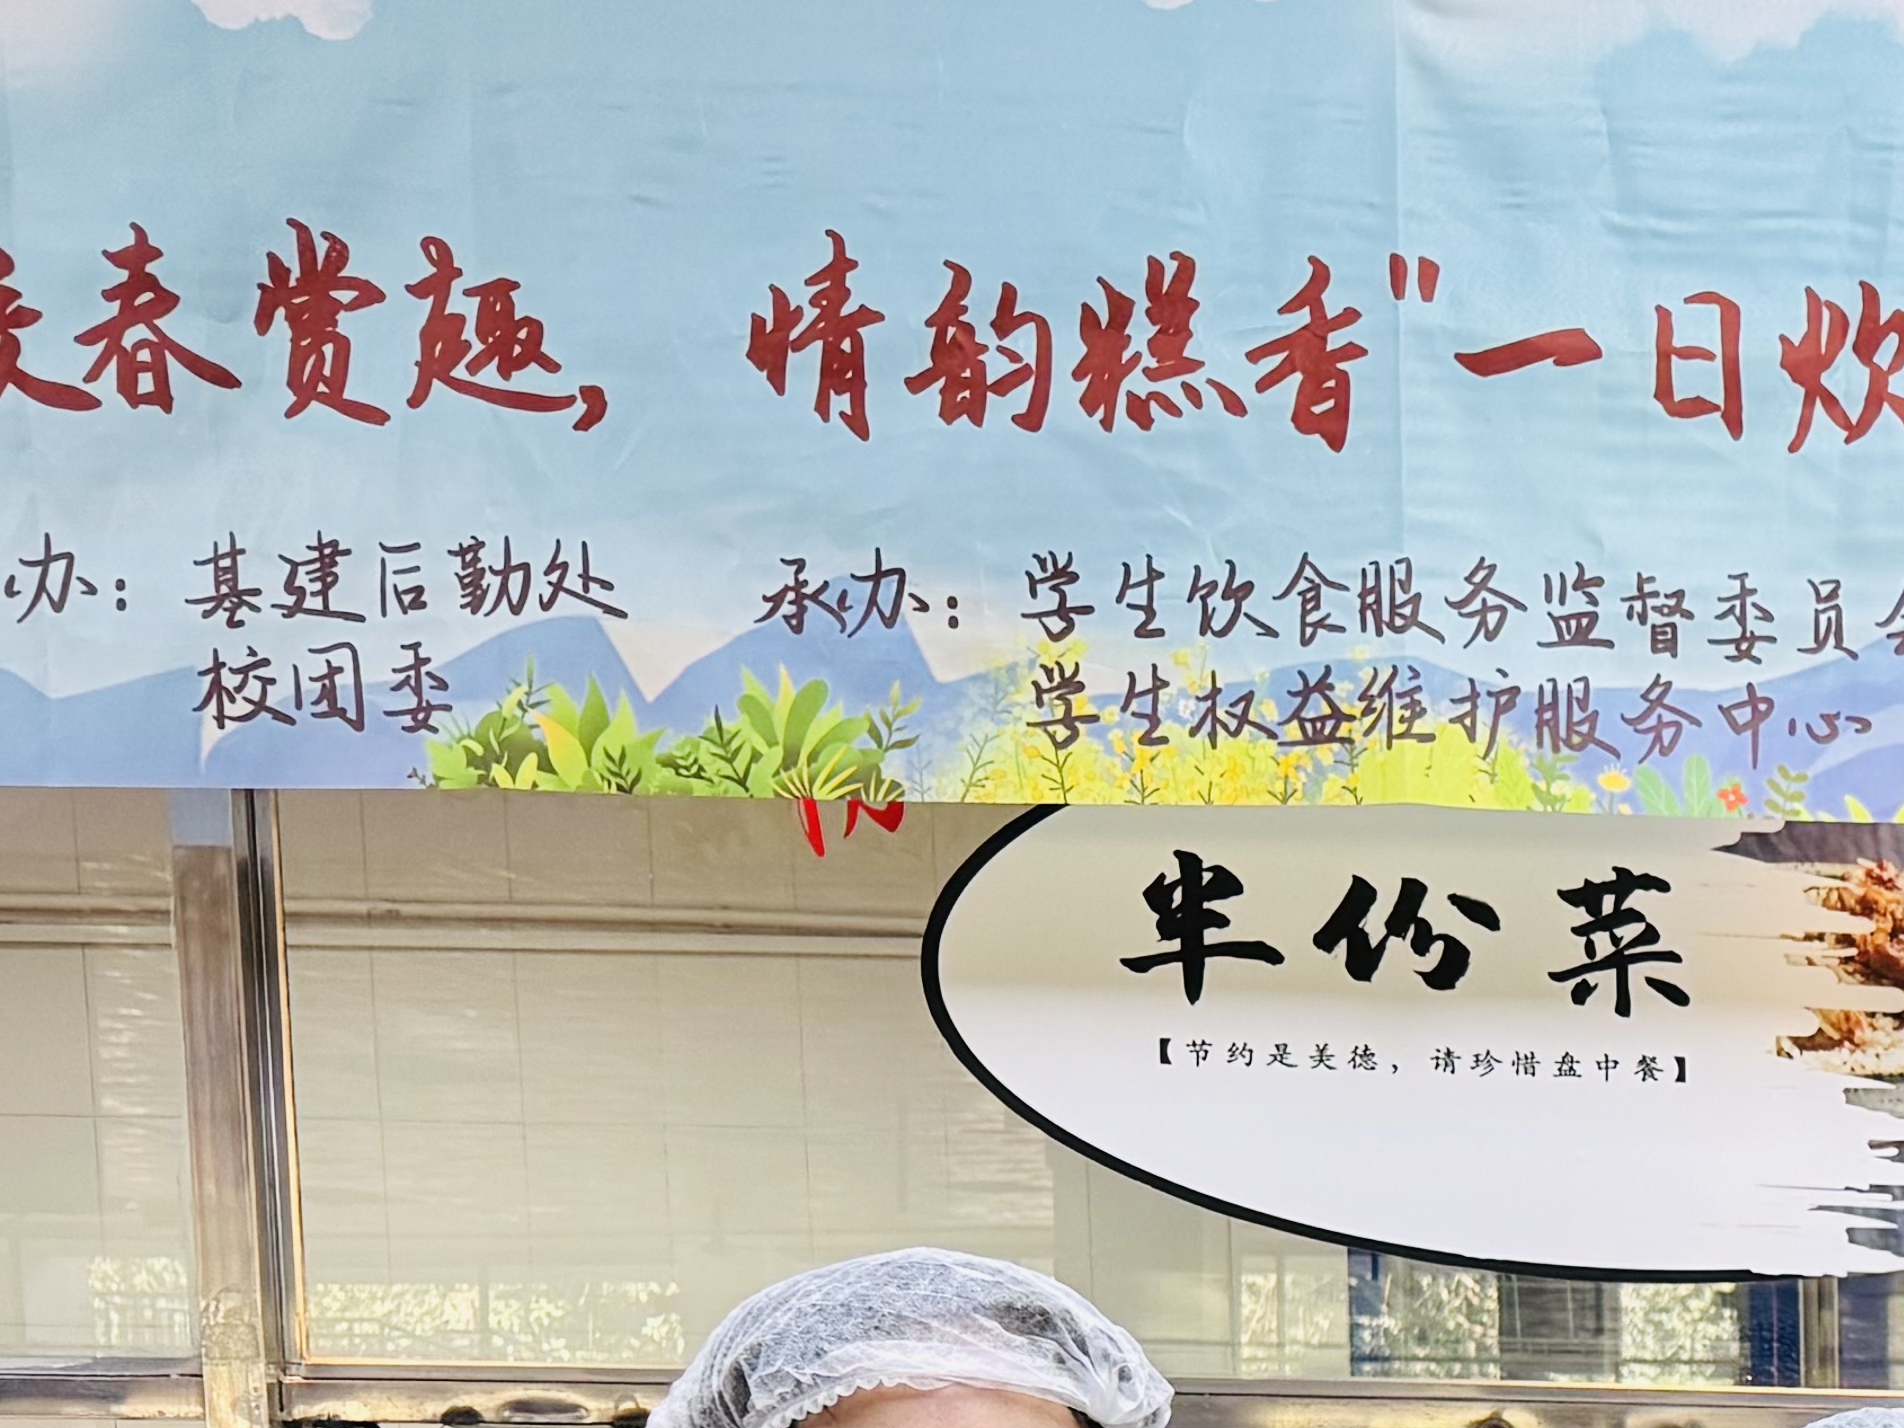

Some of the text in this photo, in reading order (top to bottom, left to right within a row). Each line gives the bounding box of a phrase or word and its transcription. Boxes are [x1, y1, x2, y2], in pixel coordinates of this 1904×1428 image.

[193, 641, 1873, 771] 校团委 学生权益维护服务中心
[1119, 849, 1690, 1017] 半份菜
